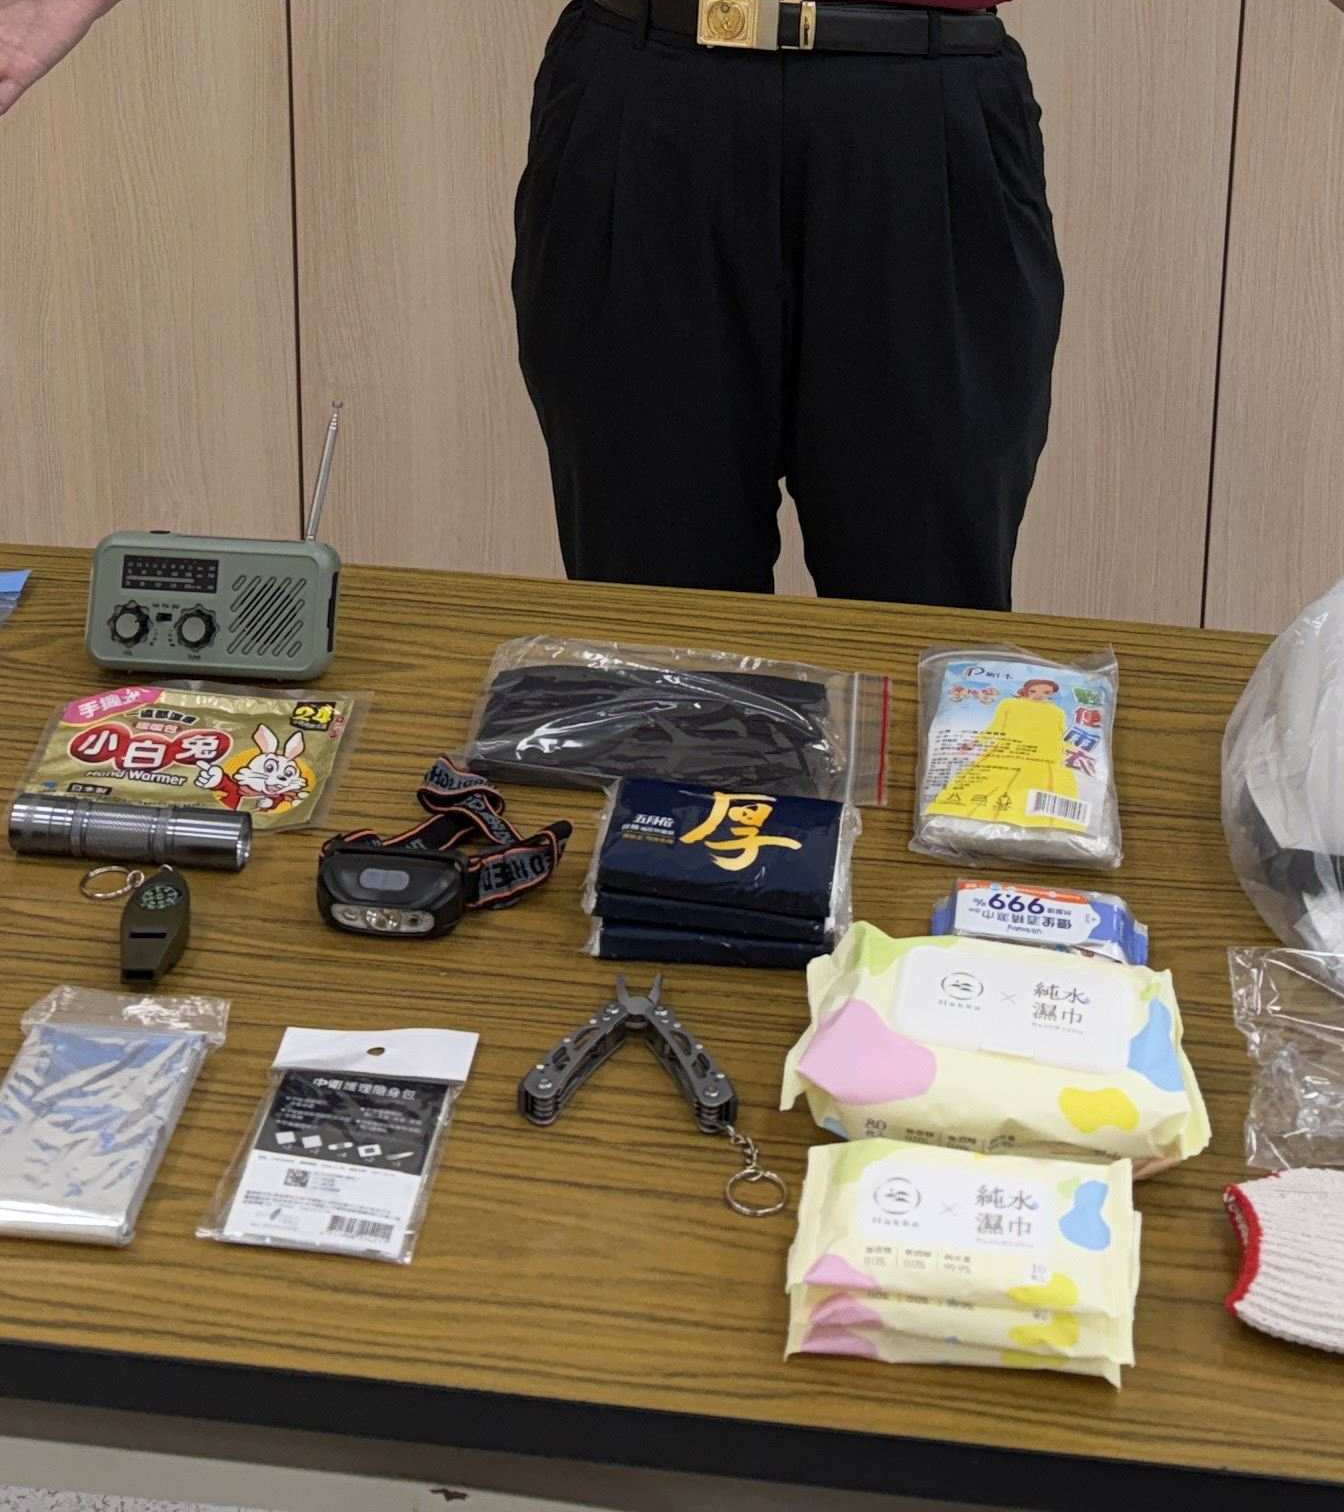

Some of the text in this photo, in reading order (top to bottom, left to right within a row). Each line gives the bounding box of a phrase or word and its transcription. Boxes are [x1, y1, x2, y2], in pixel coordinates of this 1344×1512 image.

[78, 729, 221, 769] 小白兔
[128, 769, 187, 786] Warmer
[679, 791, 803, 872] 厚
